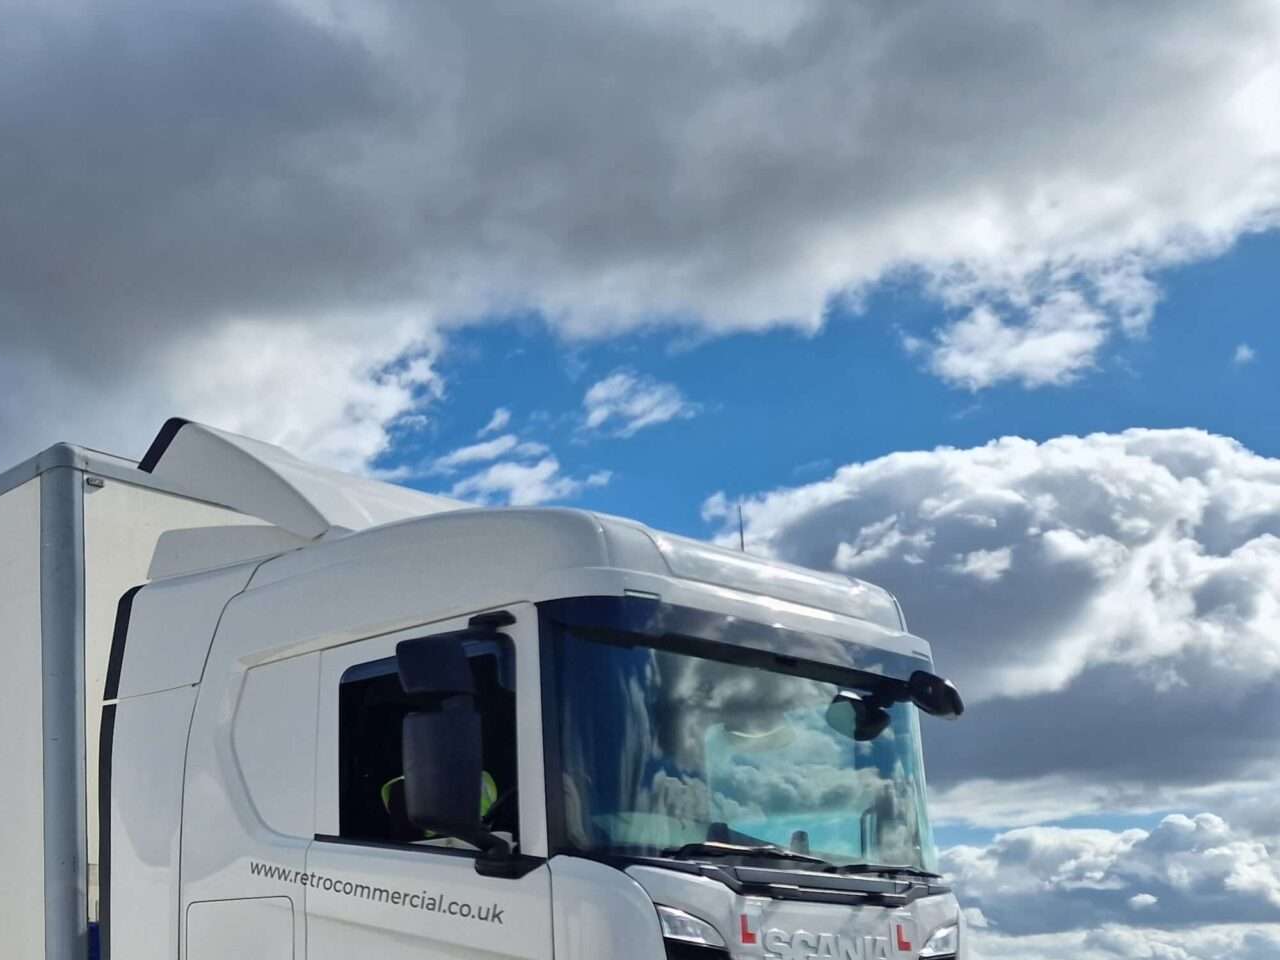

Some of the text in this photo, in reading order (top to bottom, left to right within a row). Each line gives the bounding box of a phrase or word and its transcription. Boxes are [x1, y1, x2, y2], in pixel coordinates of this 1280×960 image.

[250, 861, 504, 924] www.retrocommercial.co.uk
[740, 913, 756, 944] L
[896, 924, 912, 951] L
